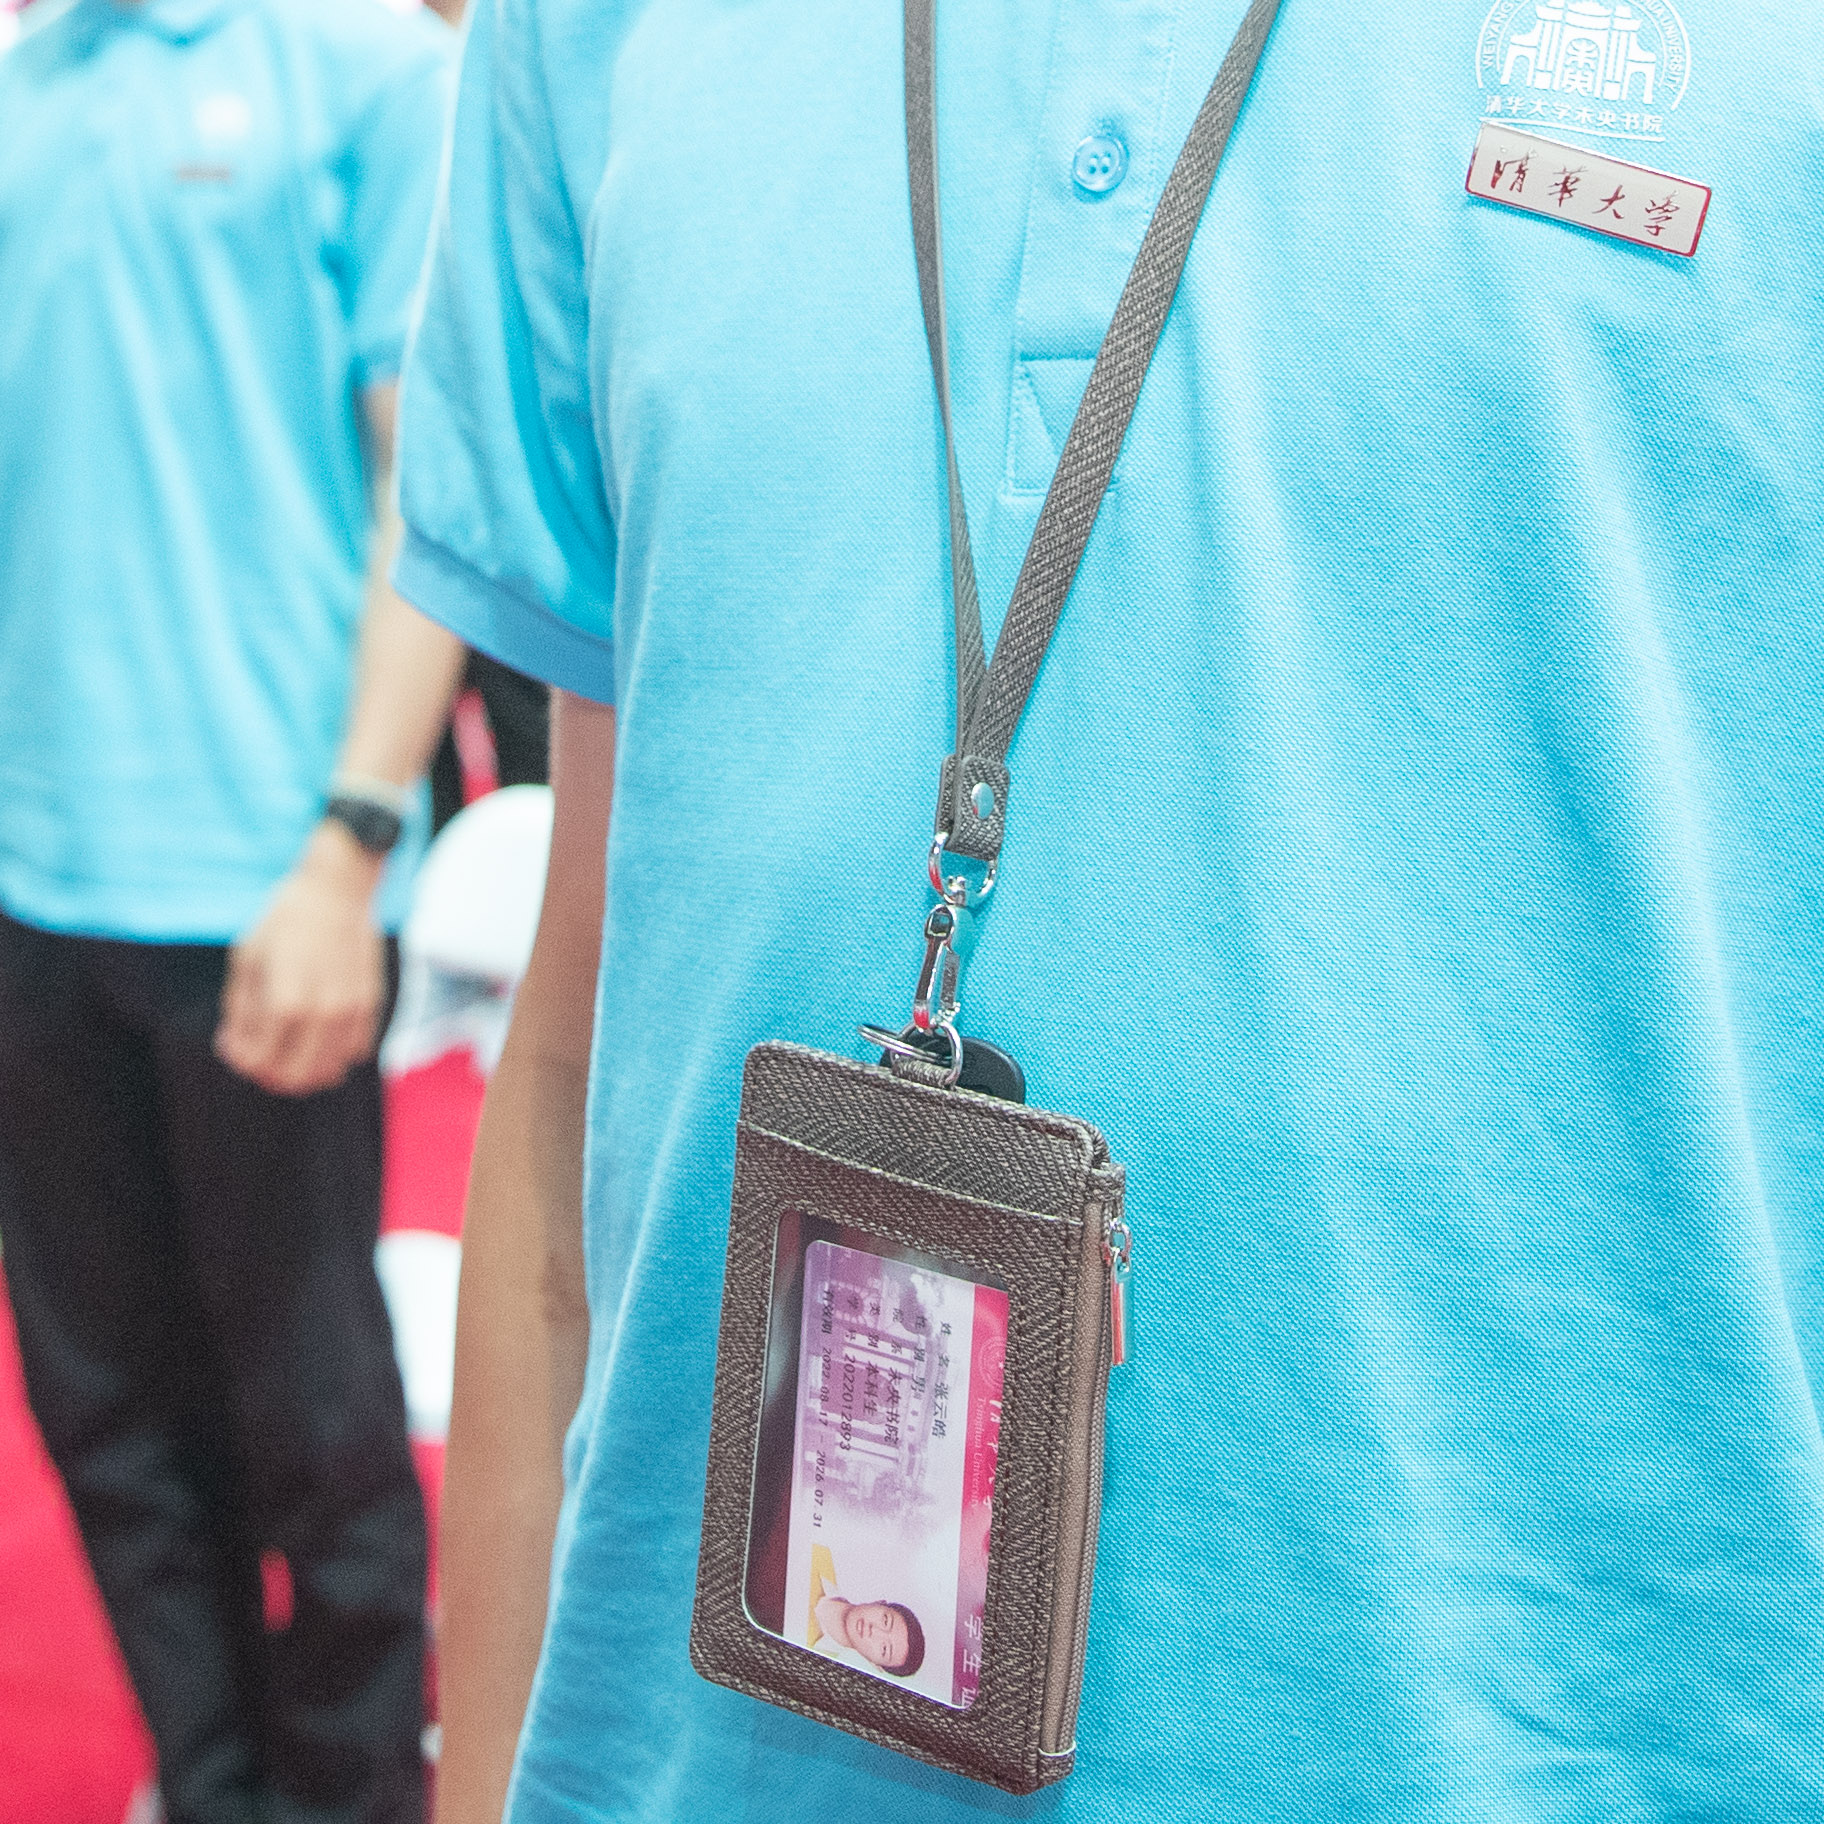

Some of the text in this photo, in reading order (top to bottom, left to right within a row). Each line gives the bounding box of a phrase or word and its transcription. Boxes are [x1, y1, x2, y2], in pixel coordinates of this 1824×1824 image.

[1482, 1, 1514, 71] WEIYANG
[1660, 17, 1684, 96] UNIVERSITY
[1484, 93, 1666, 134] 清华大学未央书院
[839, 1352, 857, 1452] 2022012893
[862, 1360, 879, 1418] 本科生
[883, 1366, 902, 1445] 未央书院
